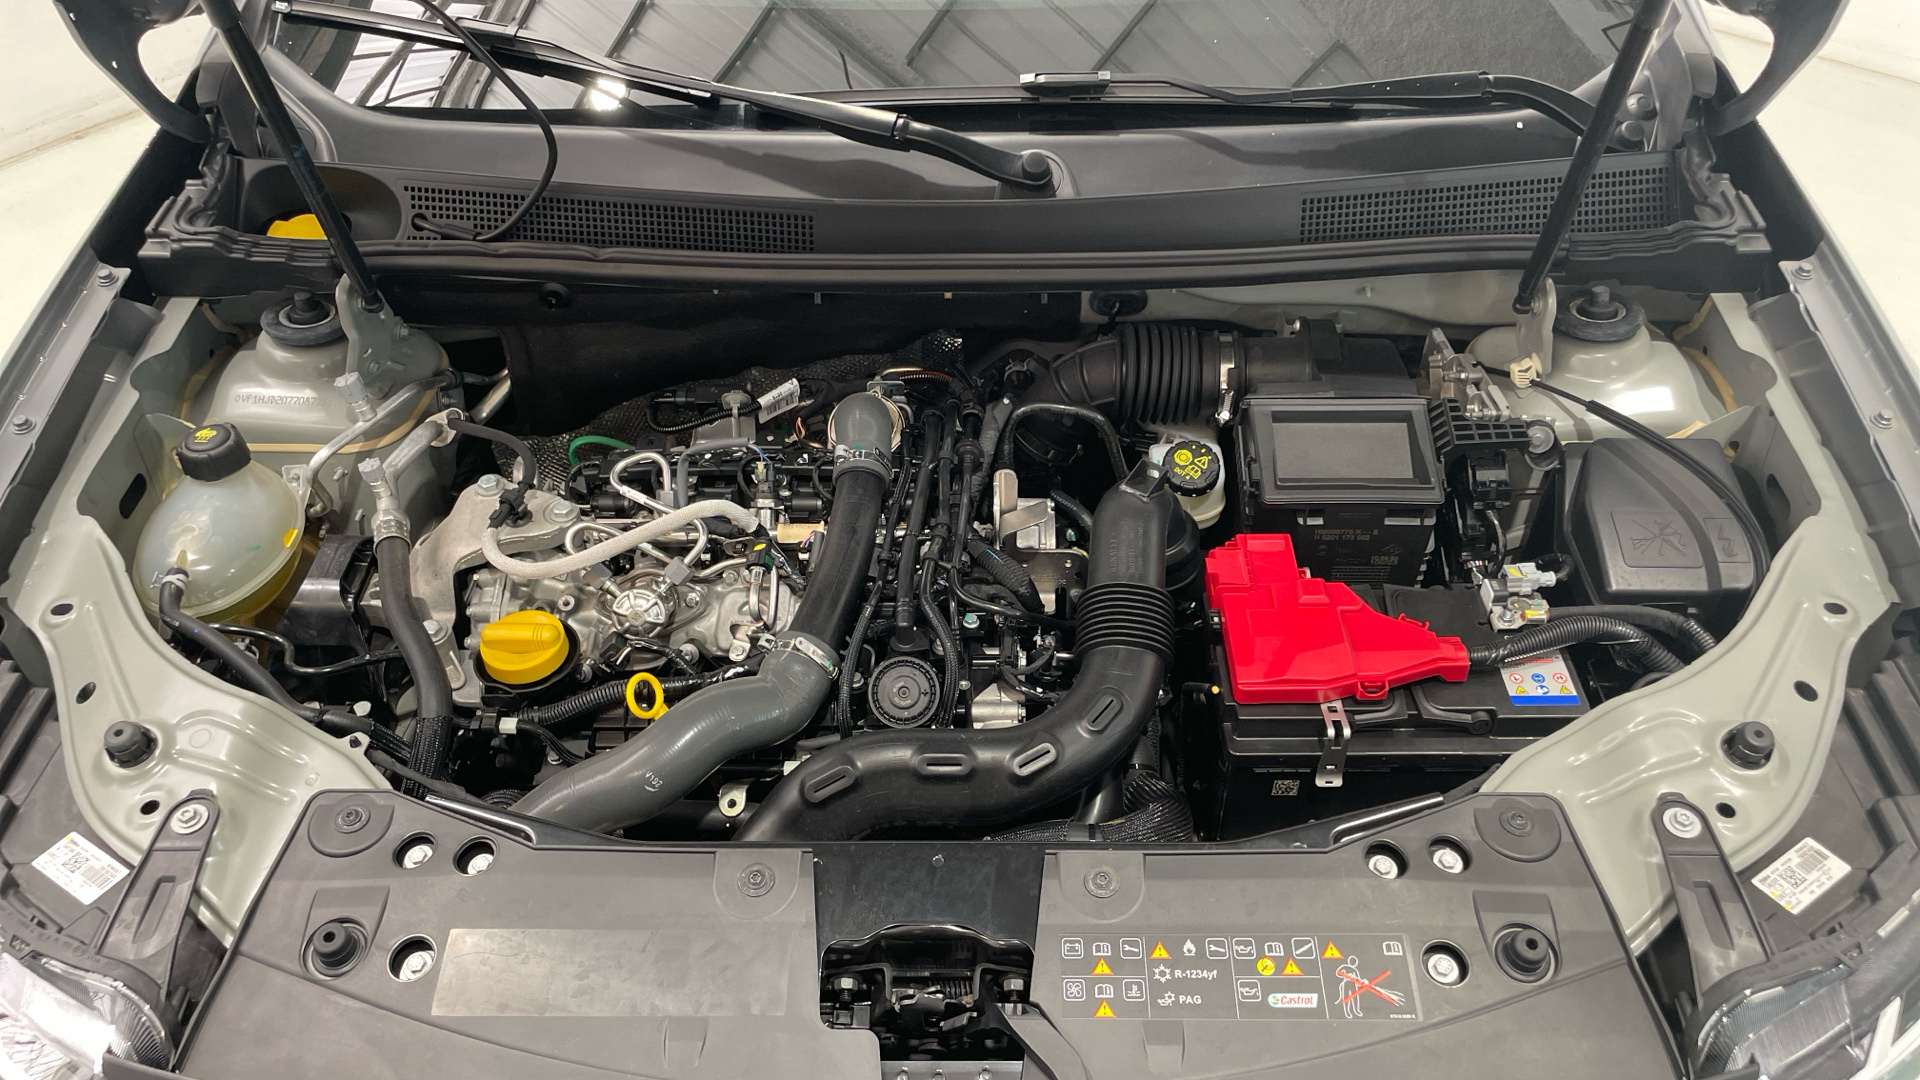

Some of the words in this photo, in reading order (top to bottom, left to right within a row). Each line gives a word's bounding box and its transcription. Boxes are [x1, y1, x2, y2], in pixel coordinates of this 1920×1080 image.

[1174, 467, 1186, 477] DOT
[1174, 969, 1218, 981] R-1234yf
[1179, 994, 1202, 1005] PAG
[1280, 994, 1314, 1006] Castrol
